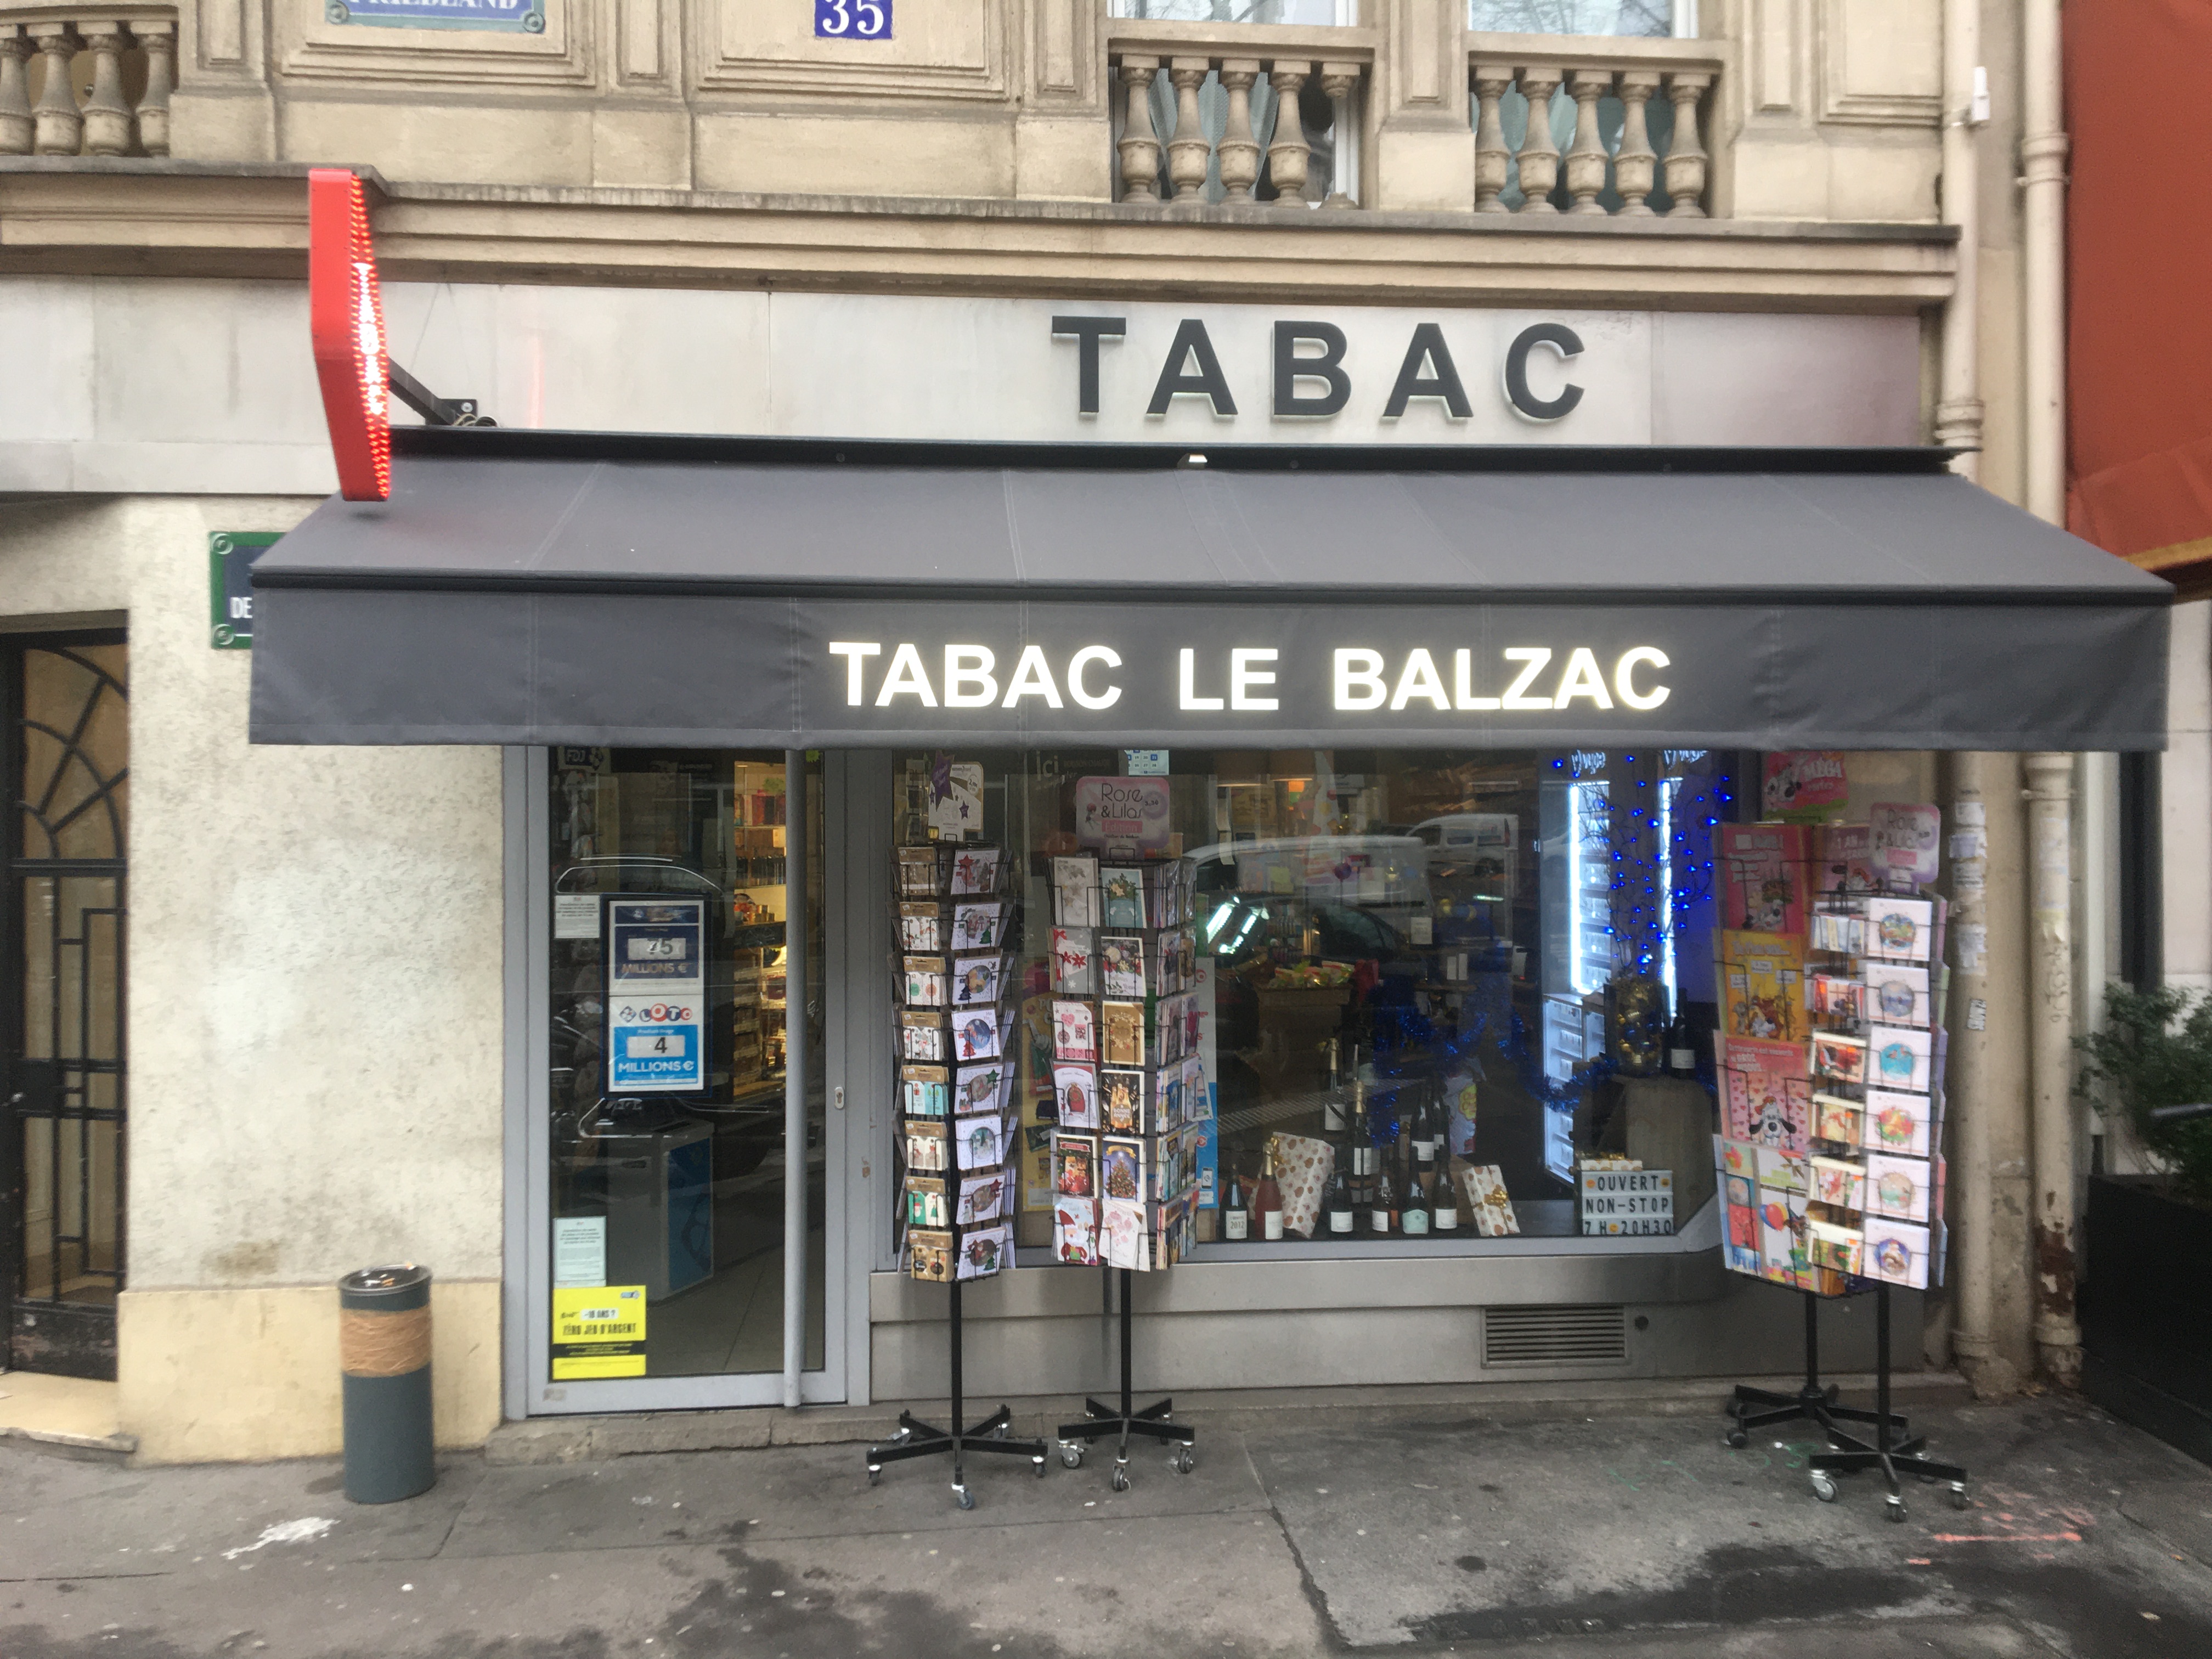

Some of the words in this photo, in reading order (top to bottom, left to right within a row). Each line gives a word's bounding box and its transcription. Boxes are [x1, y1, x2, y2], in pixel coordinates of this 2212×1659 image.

[822, 0, 884, 34] 35
[1052, 315, 1585, 420] TABAC
[828, 641, 1122, 710] TABAC
[1179, 647, 1279, 711] LE
[1333, 647, 1671, 711] BALZAC
[1102, 783, 1143, 802] Rose
[647, 938, 673, 955] 75
[621, 963, 675, 974] MILLIONS
[639, 1003, 693, 1022] LOTO
[654, 1037, 668, 1054] 4
[618, 1061, 682, 1073] MILLIONS
[1598, 1175, 1658, 1191] OUVERT
[1585, 1197, 1669, 1214] NON-STOP
[1621, 1220, 1672, 1235] 20H30
